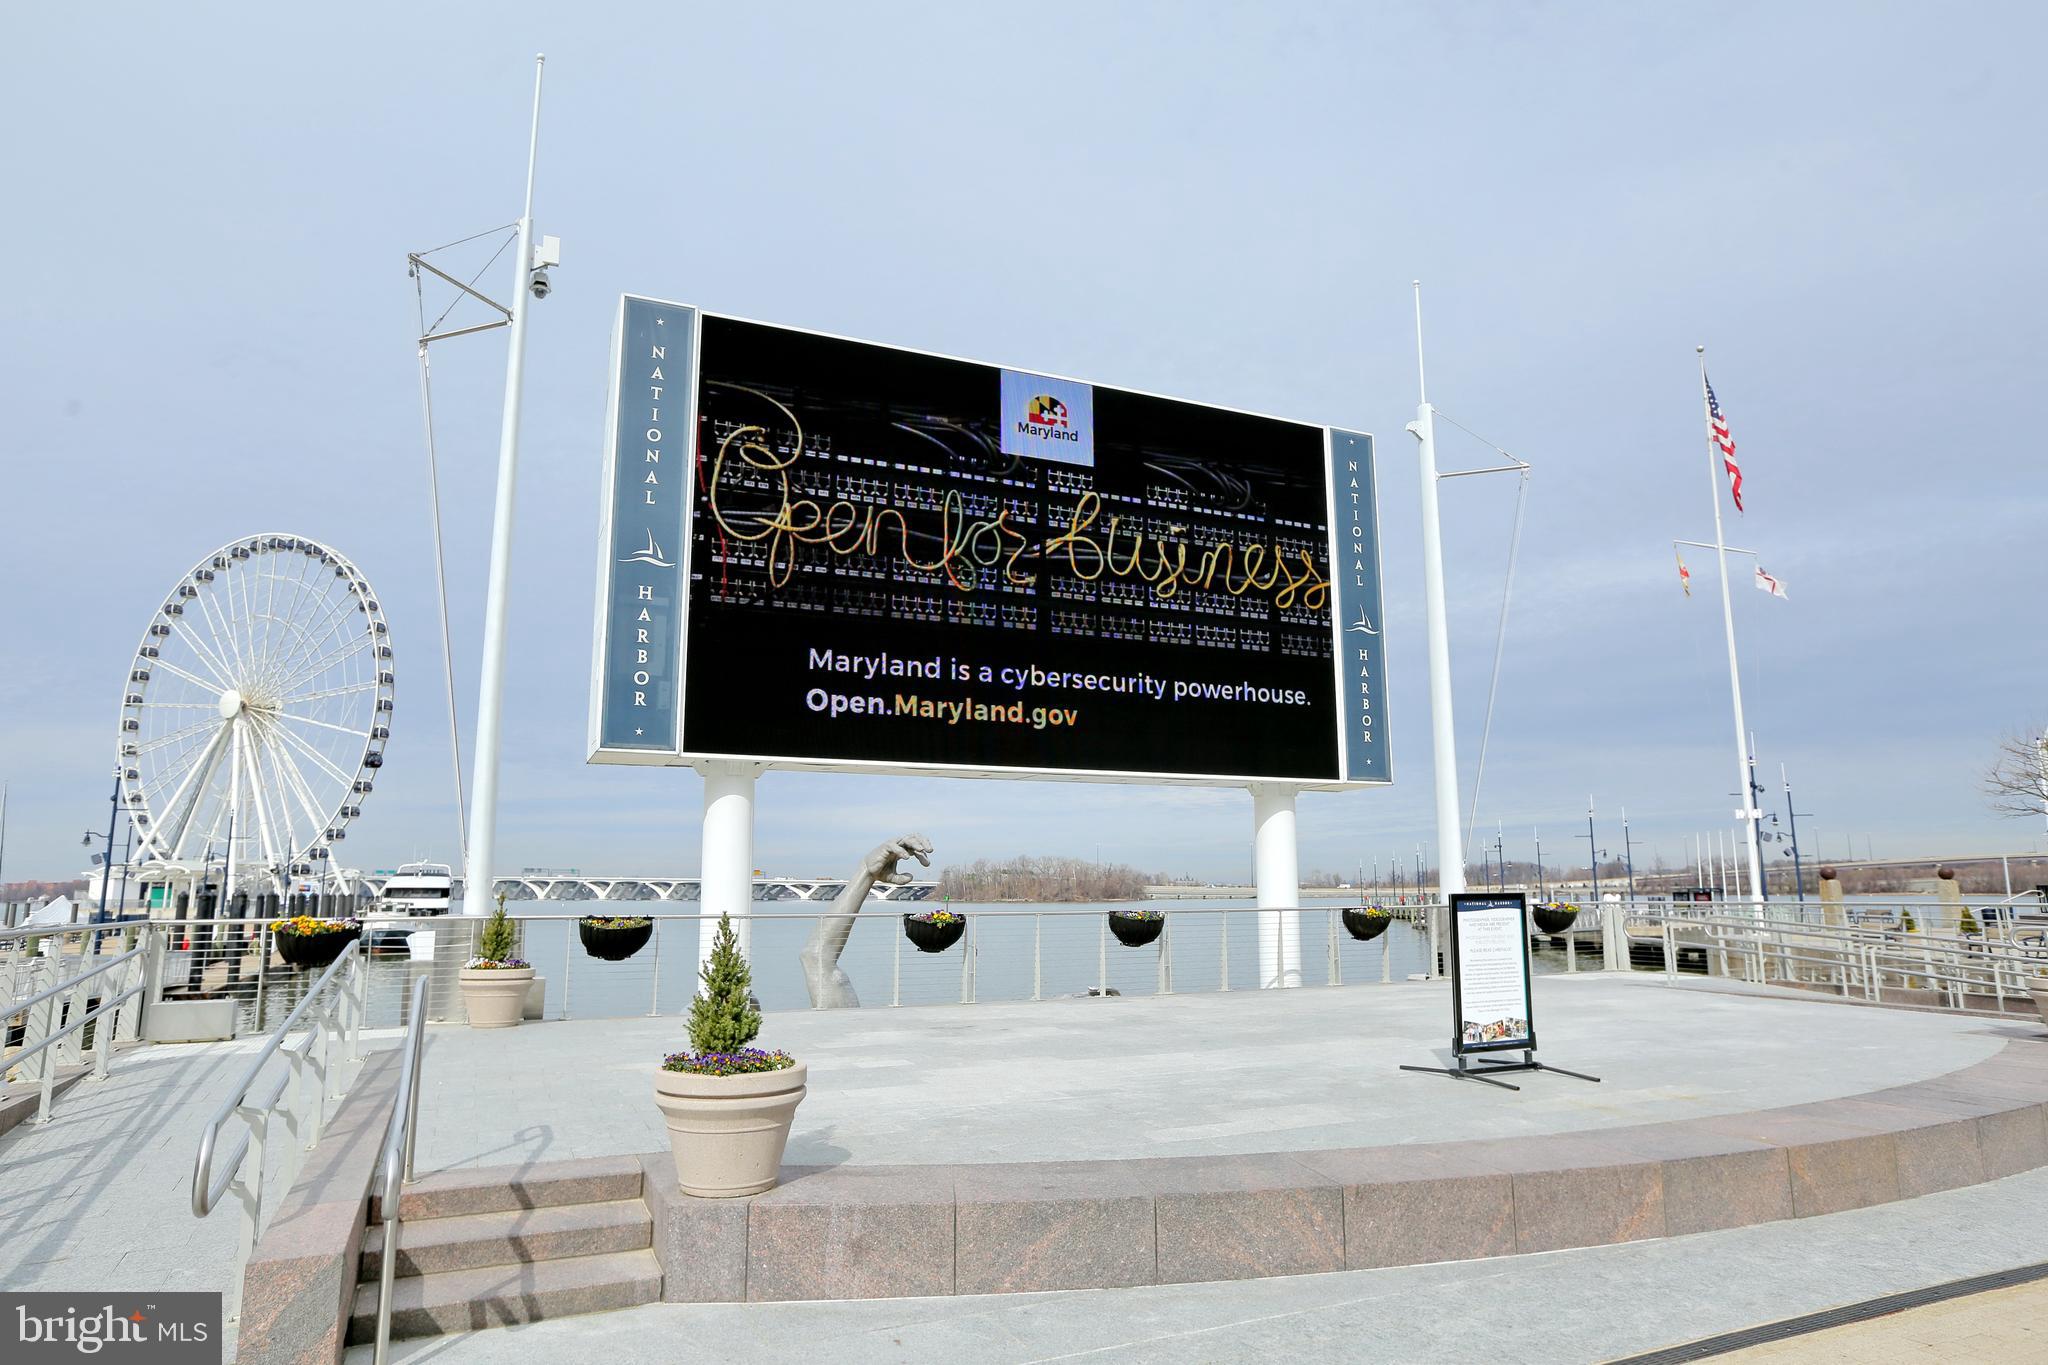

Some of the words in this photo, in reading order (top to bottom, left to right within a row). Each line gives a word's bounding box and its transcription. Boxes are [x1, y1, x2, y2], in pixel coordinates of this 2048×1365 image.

[644, 345, 666, 505] NATIONAL
[1018, 421, 1078, 441] Maryland
[706, 381, 941, 588] Open
[1349, 461, 1364, 586] NATIONAL
[633, 585, 654, 706] HARBOR
[809, 647, 941, 680] Maryland
[951, 657, 970, 681] is
[978, 665, 993, 683] a
[1000, 664, 1167, 700] cybersecurity
[1174, 679, 1312, 706] powerhouse.
[1359, 649, 1372, 743] HARBOR
[805, 687, 1078, 730] Open.Maryland.gov
